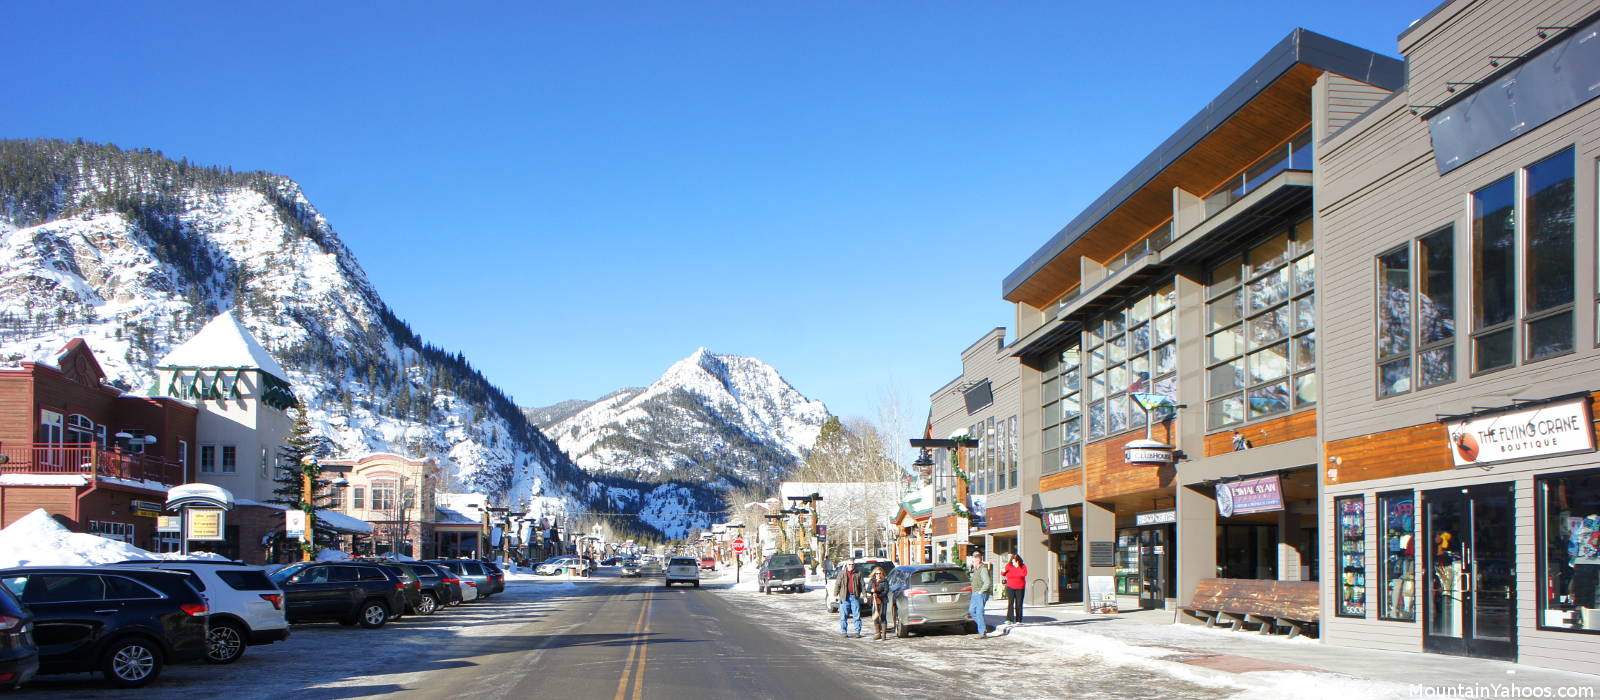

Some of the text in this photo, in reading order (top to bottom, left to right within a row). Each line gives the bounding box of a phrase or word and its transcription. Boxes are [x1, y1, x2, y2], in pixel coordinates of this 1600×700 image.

[1478, 415, 1580, 445] THE FLYING CRANE
[1501, 438, 1558, 453] BOUTIQUE
